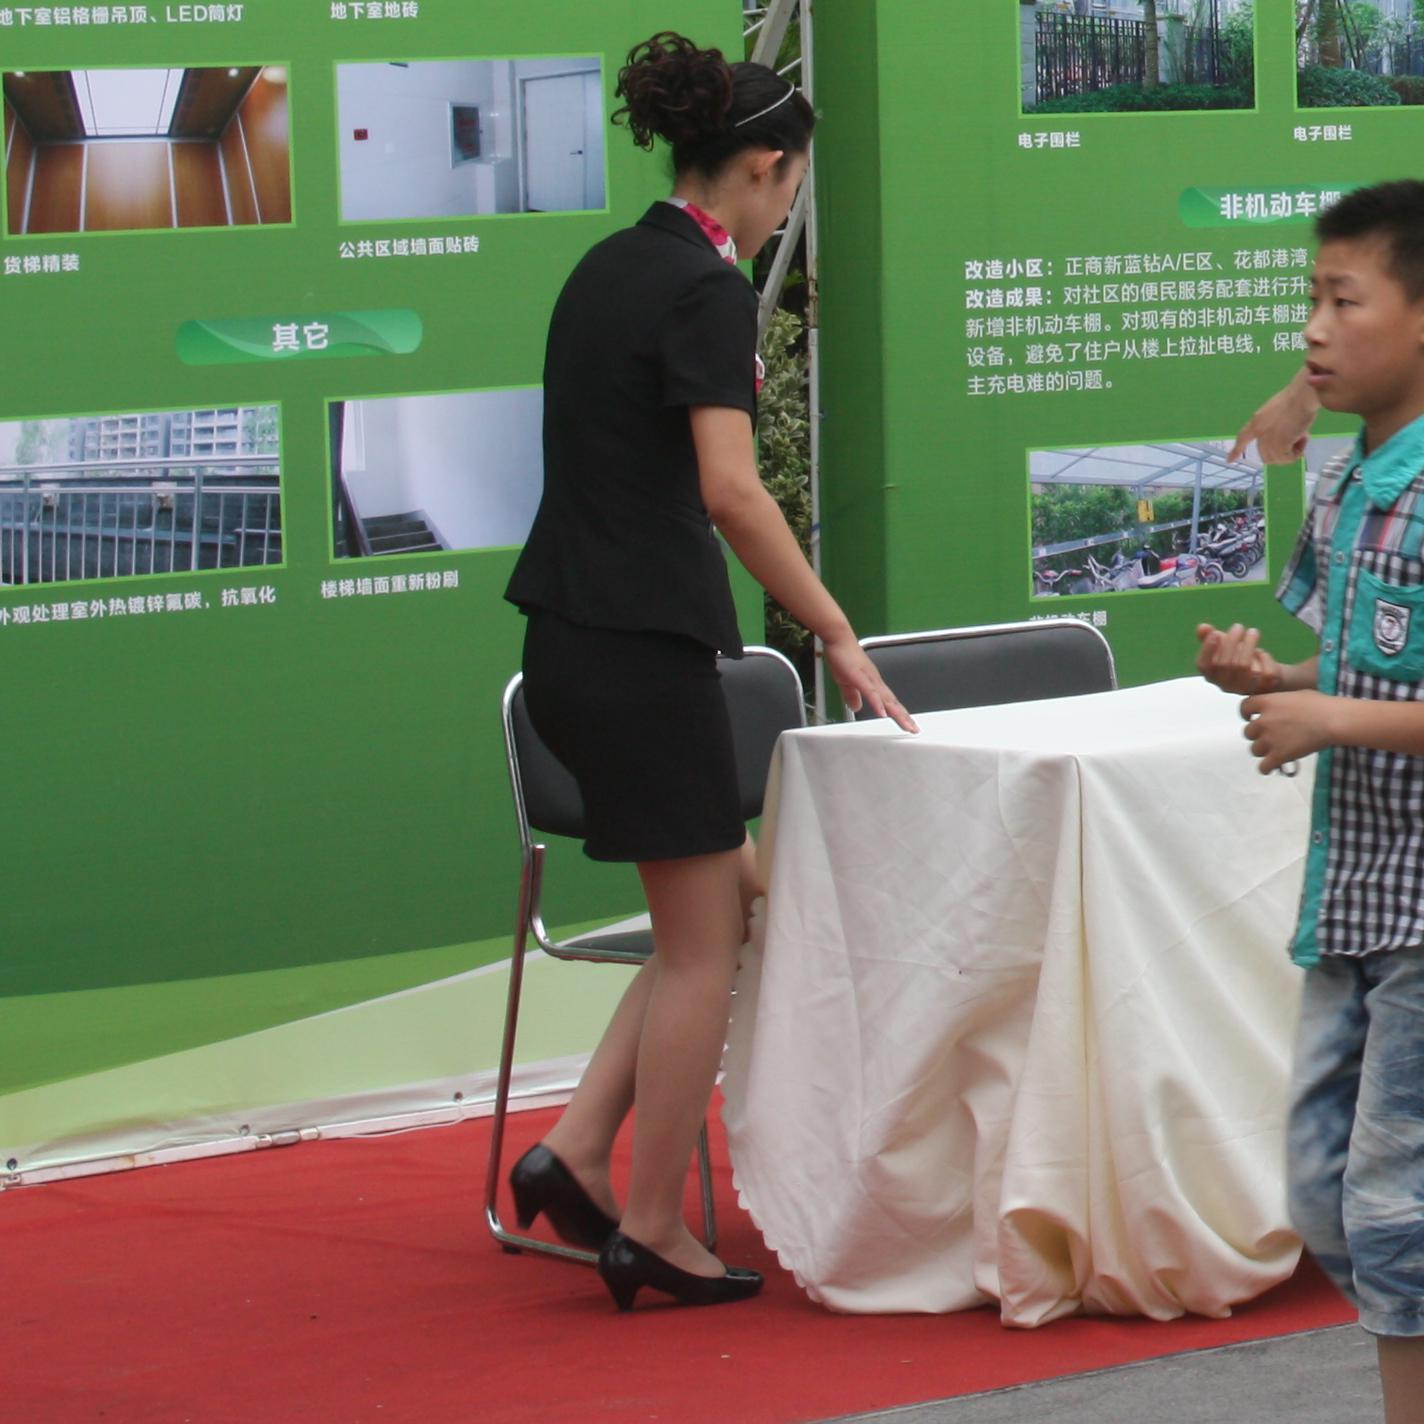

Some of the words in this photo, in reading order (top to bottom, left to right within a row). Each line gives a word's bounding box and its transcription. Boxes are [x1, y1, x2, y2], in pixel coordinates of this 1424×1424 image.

[329, 0, 418, 21] 地下室地砖
[1017, 130, 1081, 149] 电子围栏
[1293, 124, 1353, 142] 电子围栏
[338, 235, 480, 259] 公共区域墙面贴砖
[3, 252, 80, 275] 货梯精装
[964, 275, 1313, 309] 改造成果：对社区的便民服务配套进行升
[965, 303, 1312, 339] 新增非机动车棚。对现有的非机动车棚进
[271, 321, 330, 353] 其它
[967, 369, 1113, 396] 主充电难的问题。
[320, 570, 459, 599] 楼梯墙面重新粉刷
